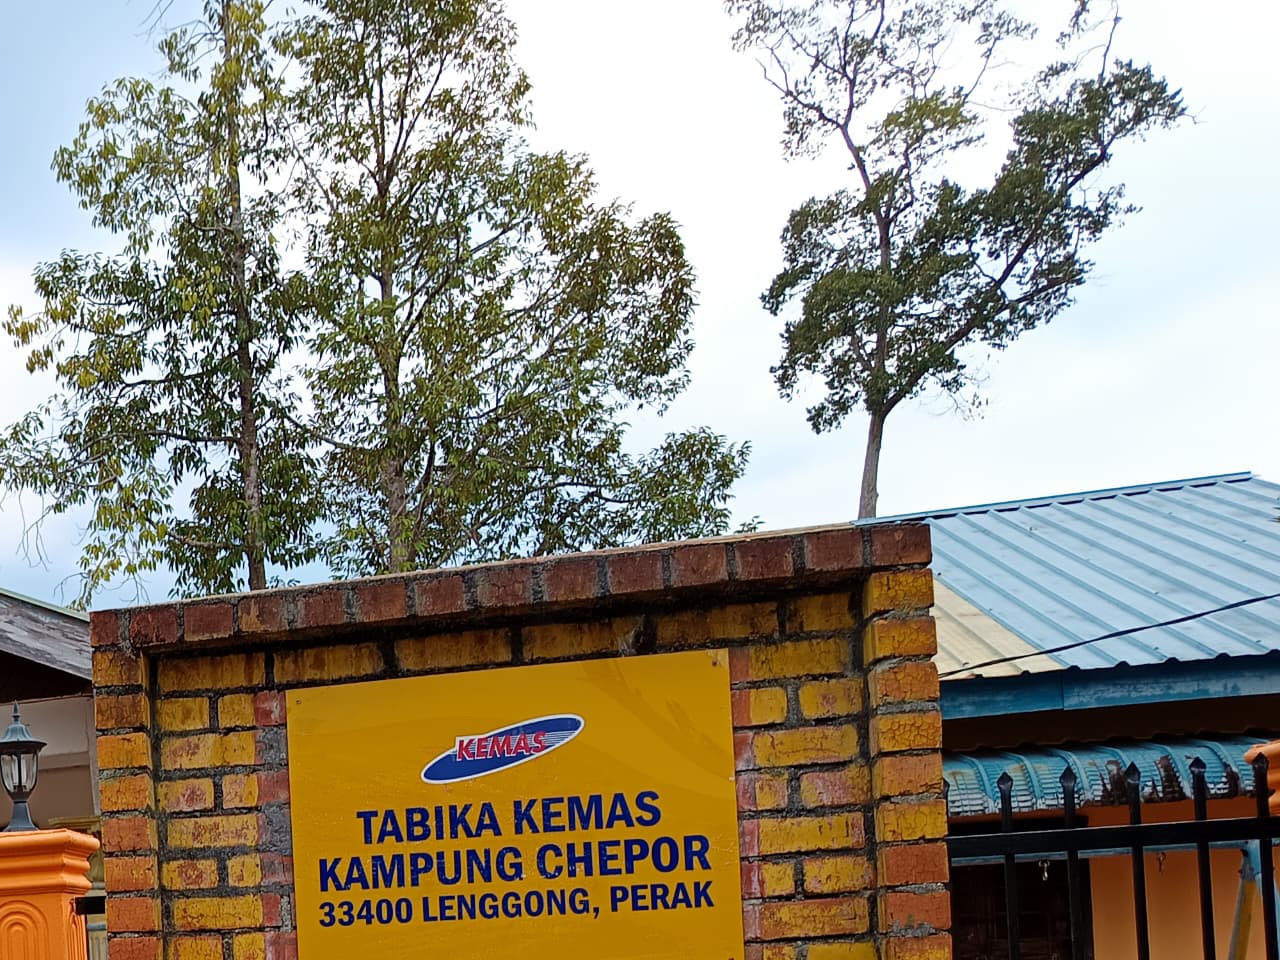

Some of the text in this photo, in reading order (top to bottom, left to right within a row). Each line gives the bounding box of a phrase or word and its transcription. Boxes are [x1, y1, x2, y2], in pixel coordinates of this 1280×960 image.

[456, 731, 548, 762] KEMAS
[357, 790, 661, 846] TABIKA KEMAS
[319, 834, 712, 892] KAMPUNG CHEPOR
[319, 880, 714, 927] 33400 LENGGONG, PERAK
